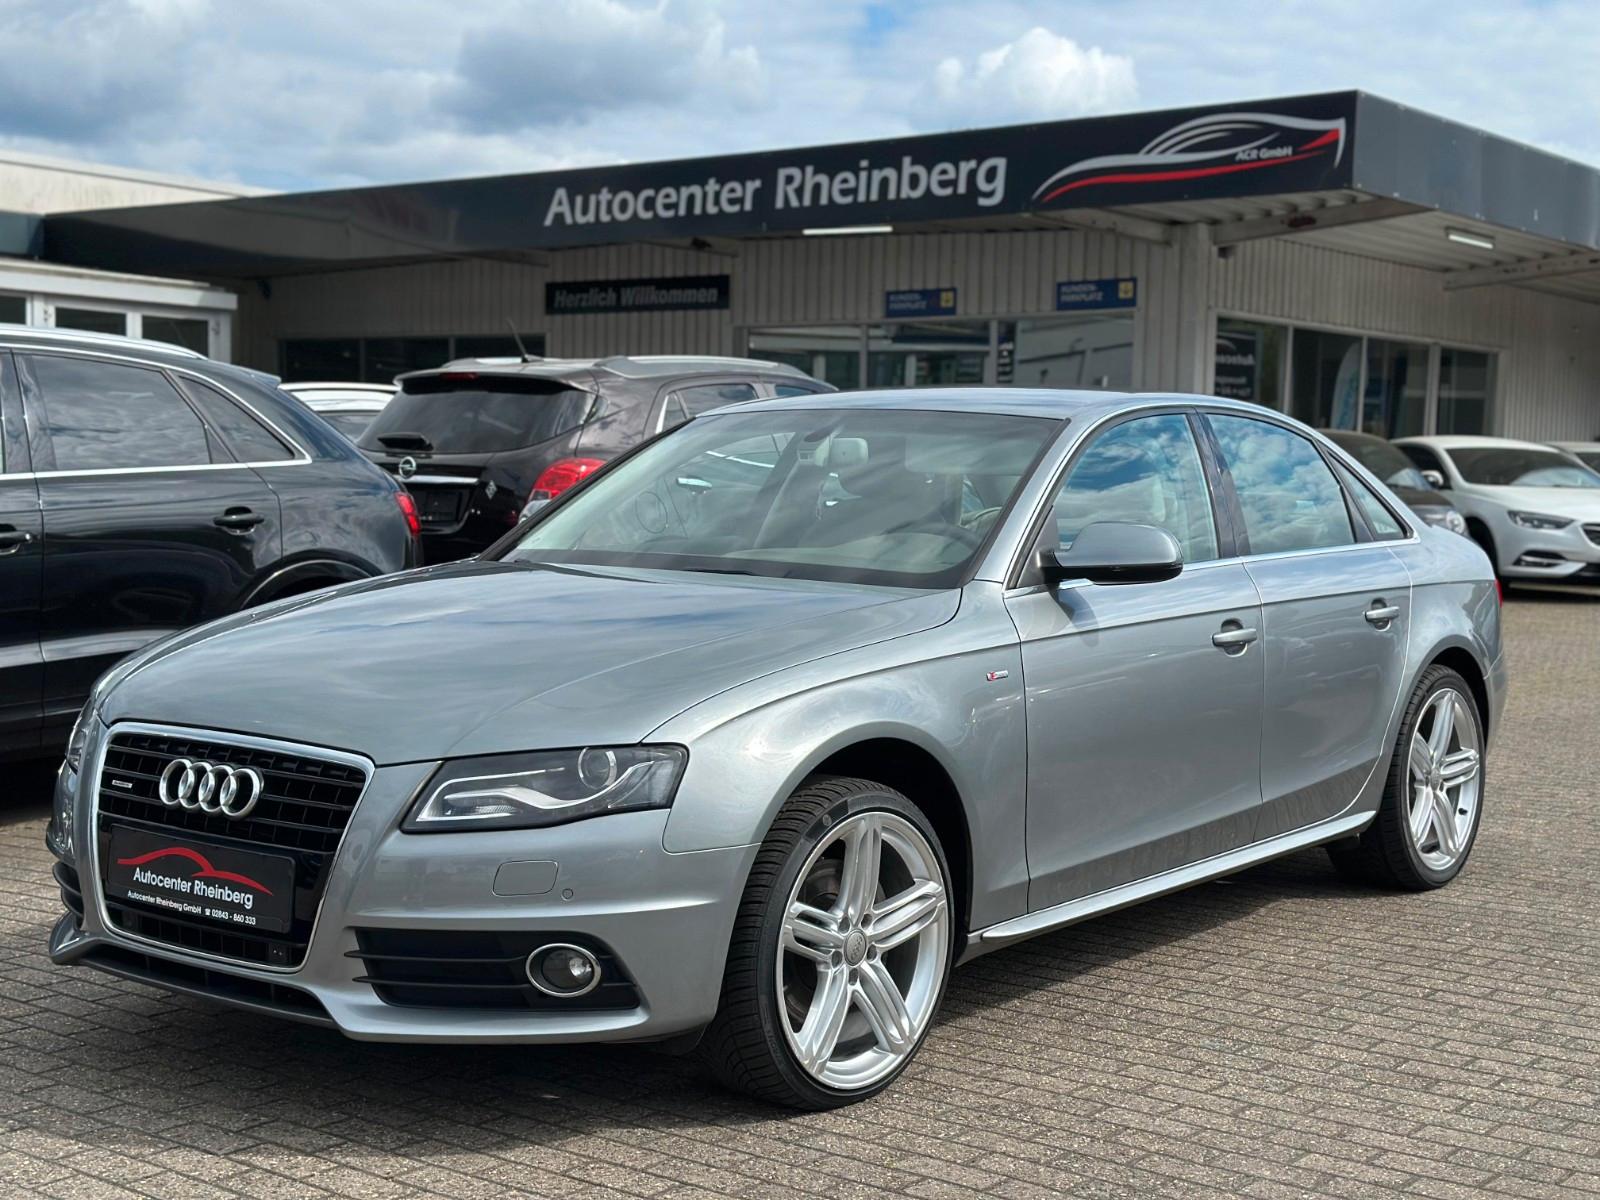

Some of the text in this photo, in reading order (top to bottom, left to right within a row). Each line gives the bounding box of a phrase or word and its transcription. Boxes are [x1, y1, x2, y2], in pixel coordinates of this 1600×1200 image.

[1259, 146, 1293, 160] GmbH
[544, 156, 1007, 226] Autocenter Rheinberg
[553, 286, 719, 308] Herzlich Willkommen
[133, 866, 253, 909] Autocenter Rheinberg
[127, 889, 155, 903] Autocenter
[156, 897, 182, 911] Rheinberg
[183, 903, 202, 914] GmbH
[211, 909, 229, 919] 02843
[233, 913, 245, 922] 860
[245, 915, 256, 925] 333
